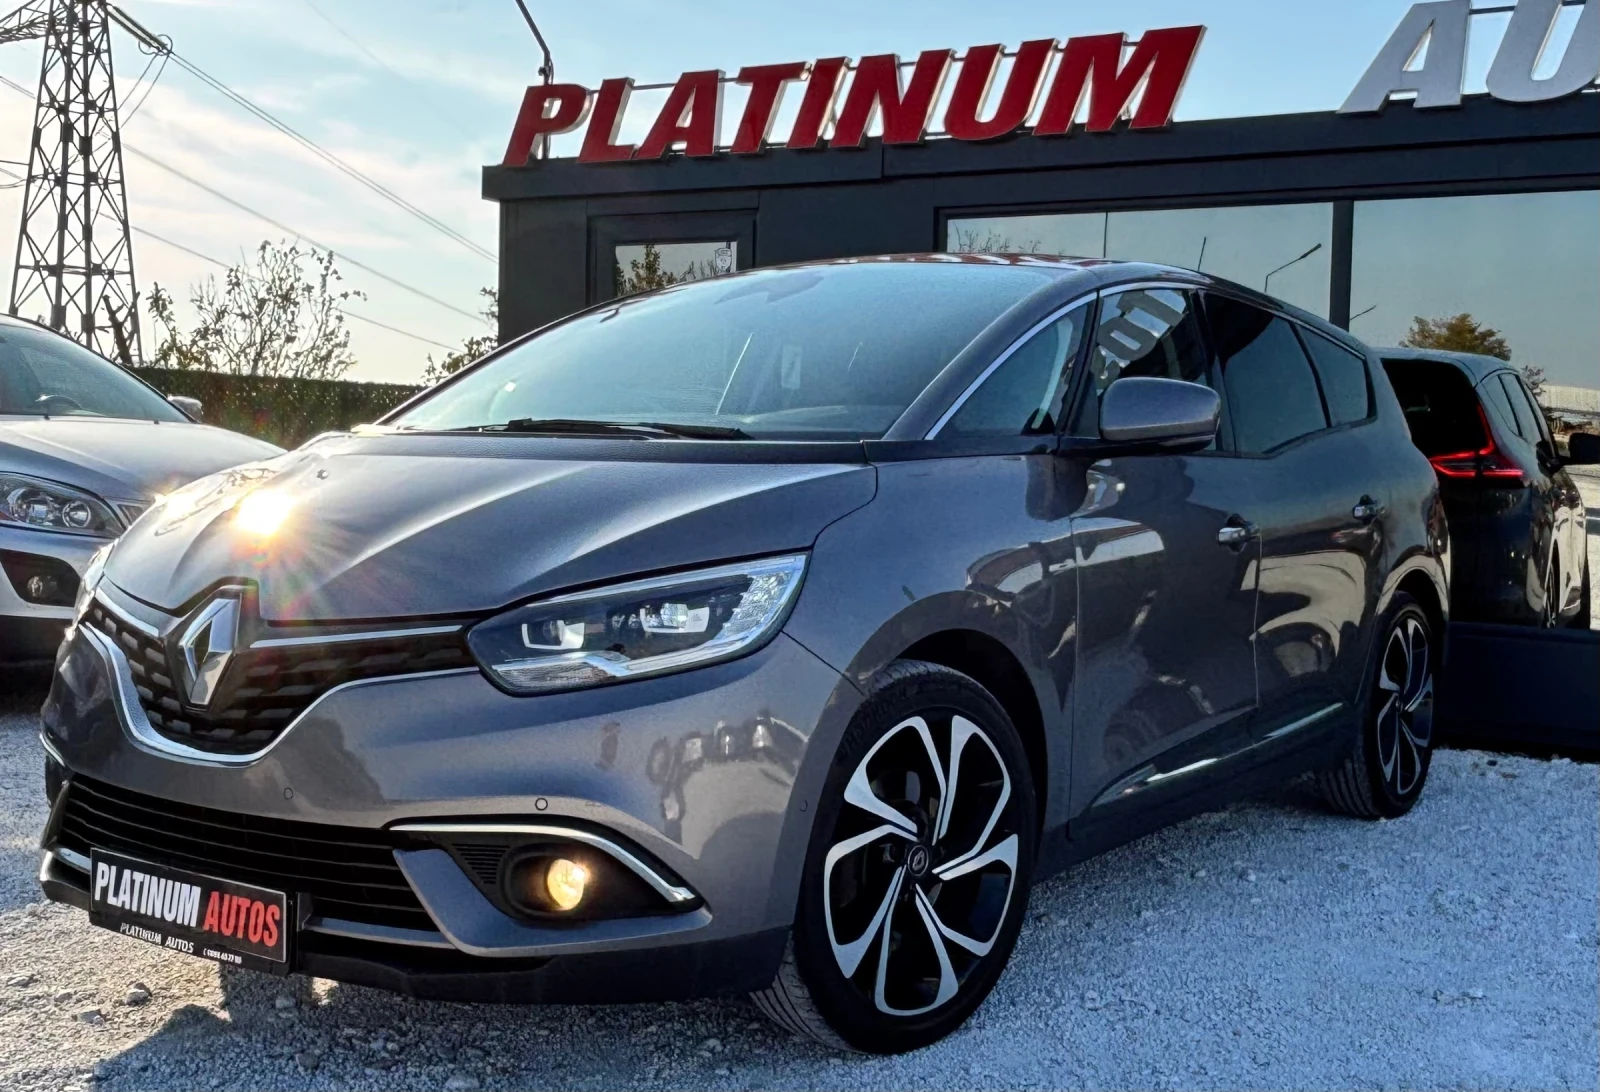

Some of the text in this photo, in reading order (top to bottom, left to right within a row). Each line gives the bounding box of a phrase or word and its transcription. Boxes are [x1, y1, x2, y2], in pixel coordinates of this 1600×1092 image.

[502, 25, 1206, 167] PLATINUM
[95, 862, 280, 947] PLATINUM AUTOS
[164, 936, 194, 954] AUTOS
